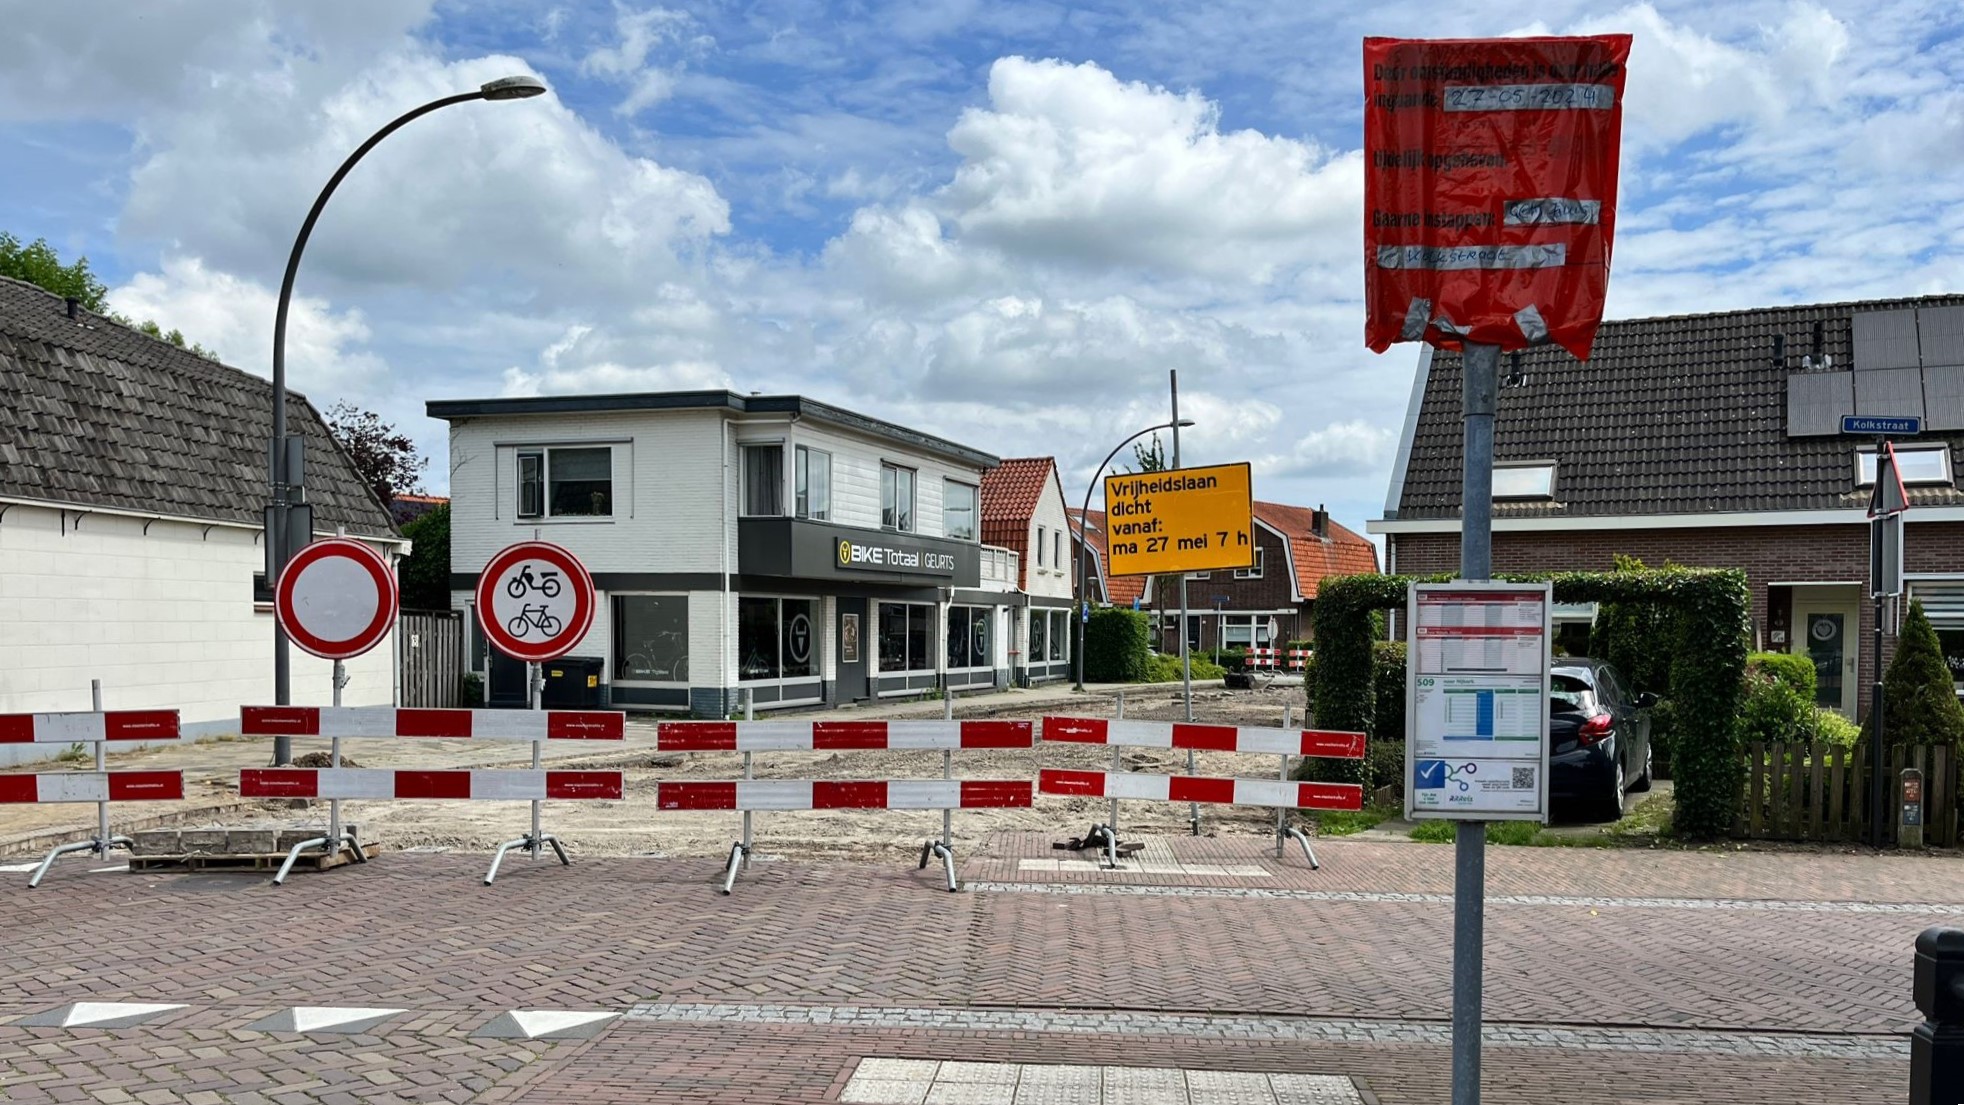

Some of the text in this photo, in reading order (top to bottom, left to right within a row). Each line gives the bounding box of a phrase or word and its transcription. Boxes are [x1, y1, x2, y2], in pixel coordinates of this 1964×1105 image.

[1373, 209, 1420, 228] Gaarne
[1853, 420, 1909, 430] Kolkstraat
[1111, 475, 1217, 500] Vrijheidslaan
[1111, 499, 1152, 516] dicht
[1112, 518, 1163, 536] vanaf:
[1112, 530, 1248, 556] ma 27 mei 7 h
[851, 544, 955, 571] BIKE Totaal GEURTS
[1417, 678, 1435, 687] 509
